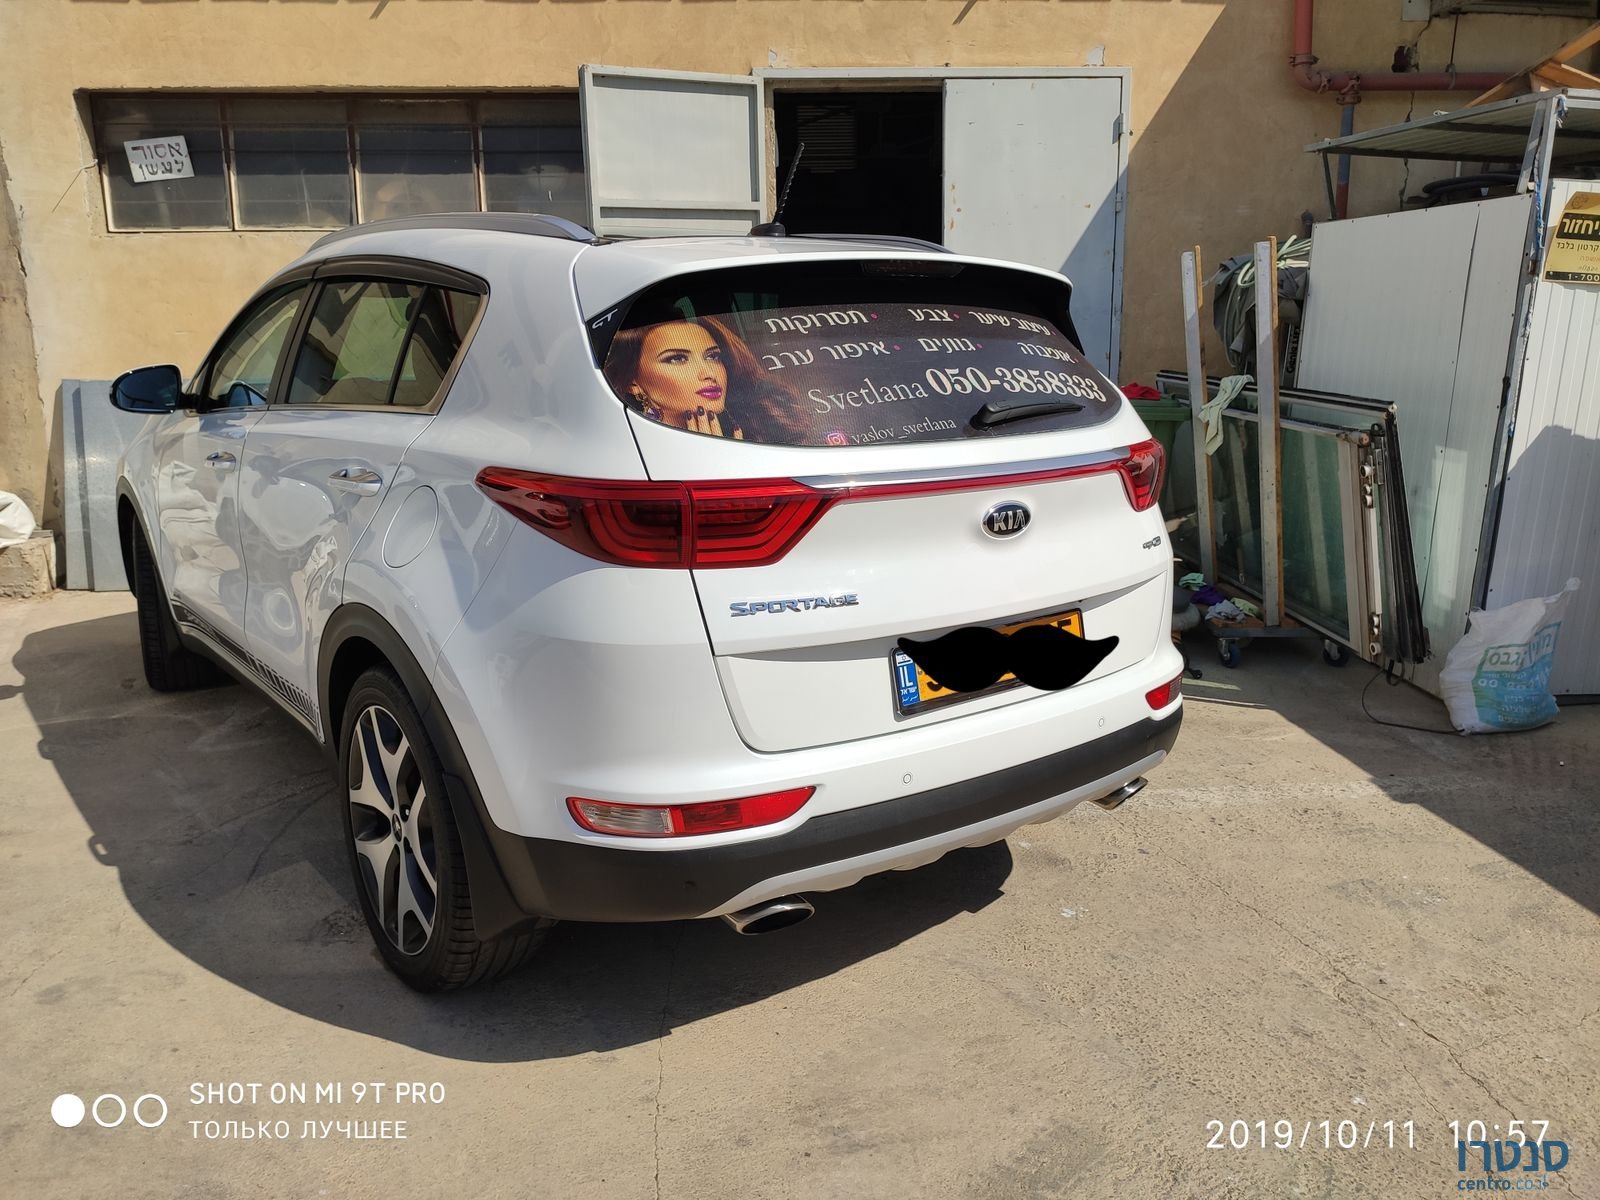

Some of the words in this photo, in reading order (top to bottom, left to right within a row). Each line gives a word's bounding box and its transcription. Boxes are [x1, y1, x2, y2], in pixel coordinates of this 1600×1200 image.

[131, 143, 184, 160] אסור
[138, 159, 185, 180] לעשן
[1562, 218, 1600, 235] יחזור
[764, 310, 869, 334] תסרוקות
[907, 308, 954, 322] צבע
[968, 311, 1011, 327] שיער
[1011, 317, 1051, 336] עיצוב
[819, 340, 891, 360] איפור
[917, 337, 977, 354] גוונים
[761, 348, 815, 371] ערב
[807, 377, 929, 414] Svetlana
[925, 366, 1107, 402] 050-3858333
[993, 509, 1026, 532] KIA
[729, 593, 859, 617] SPORTAGE
[899, 665, 914, 688] IL
